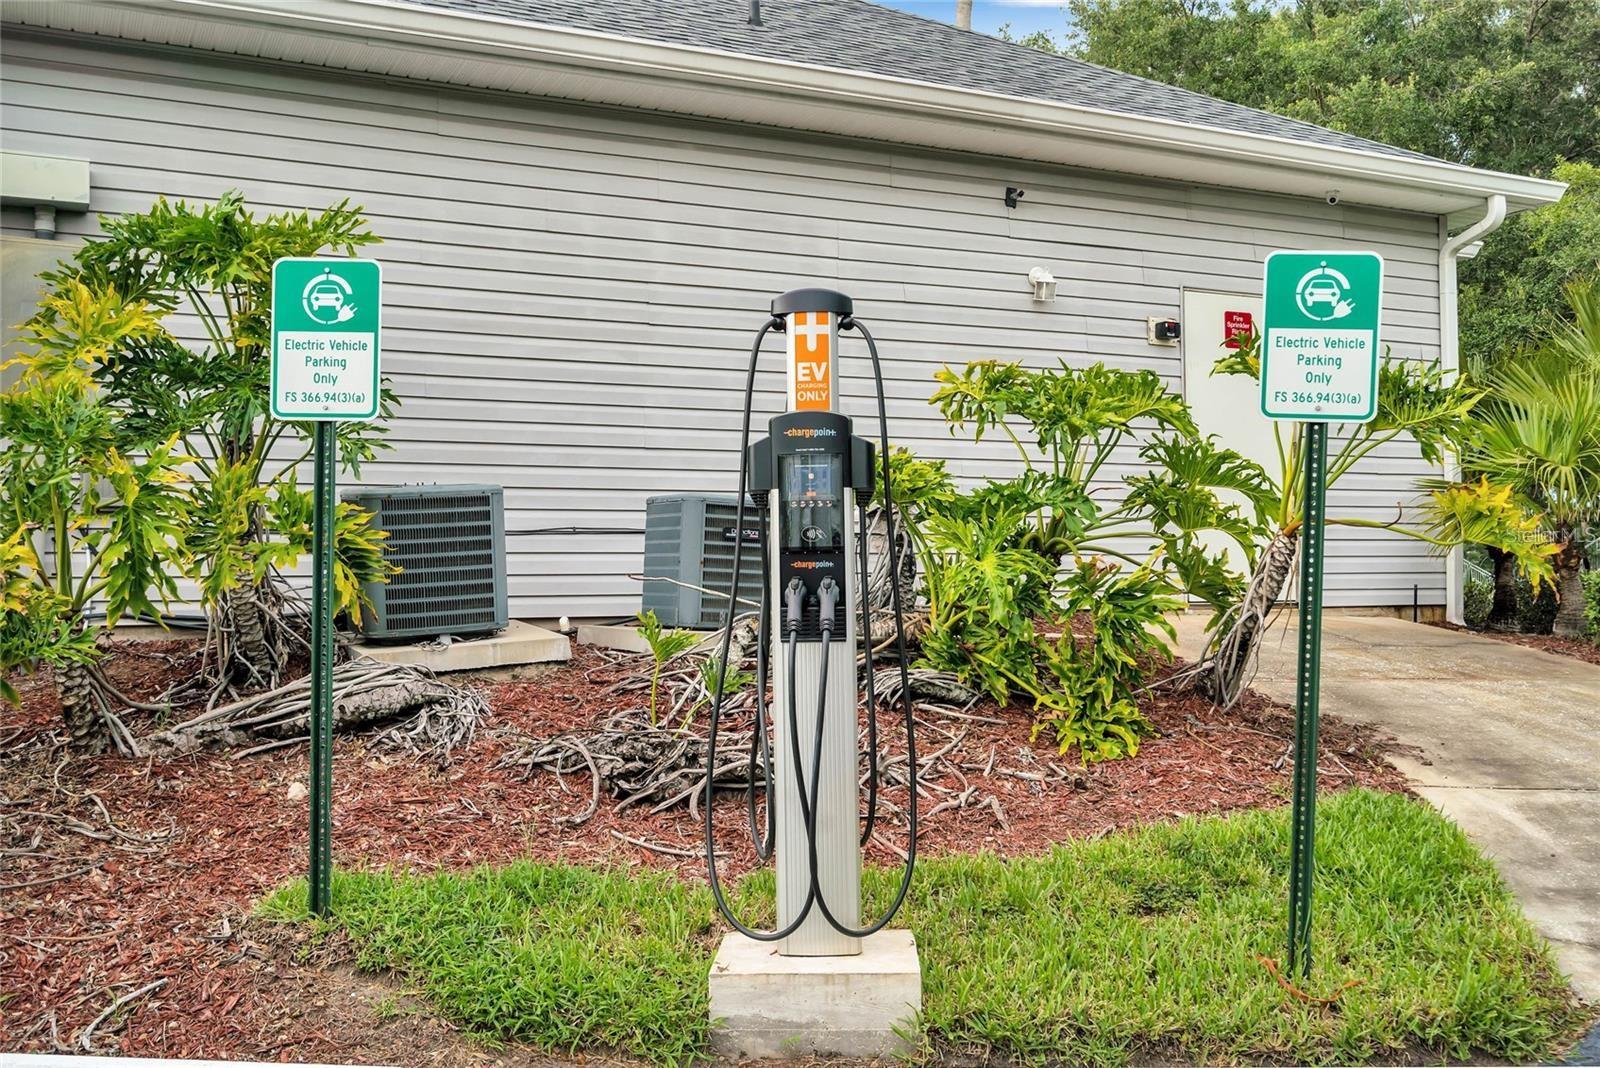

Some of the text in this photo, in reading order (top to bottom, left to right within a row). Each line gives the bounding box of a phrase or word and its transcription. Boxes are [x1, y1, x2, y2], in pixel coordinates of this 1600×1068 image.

[1227, 321, 1250, 329] Sprinkler
[285, 339, 368, 351] Electric Vehicle
[1276, 336, 1365, 349] Electric Vehicle
[305, 356, 347, 370] Parking
[1297, 354, 1342, 369] Parking
[797, 362, 827, 381] EV
[313, 373, 338, 386] Only
[1306, 372, 1332, 385] Only
[285, 392, 365, 403] FS 366.94(3)(a)
[797, 391, 828, 401] ONLY
[1275, 392, 1361, 404] FS 366.94(3)(a)
